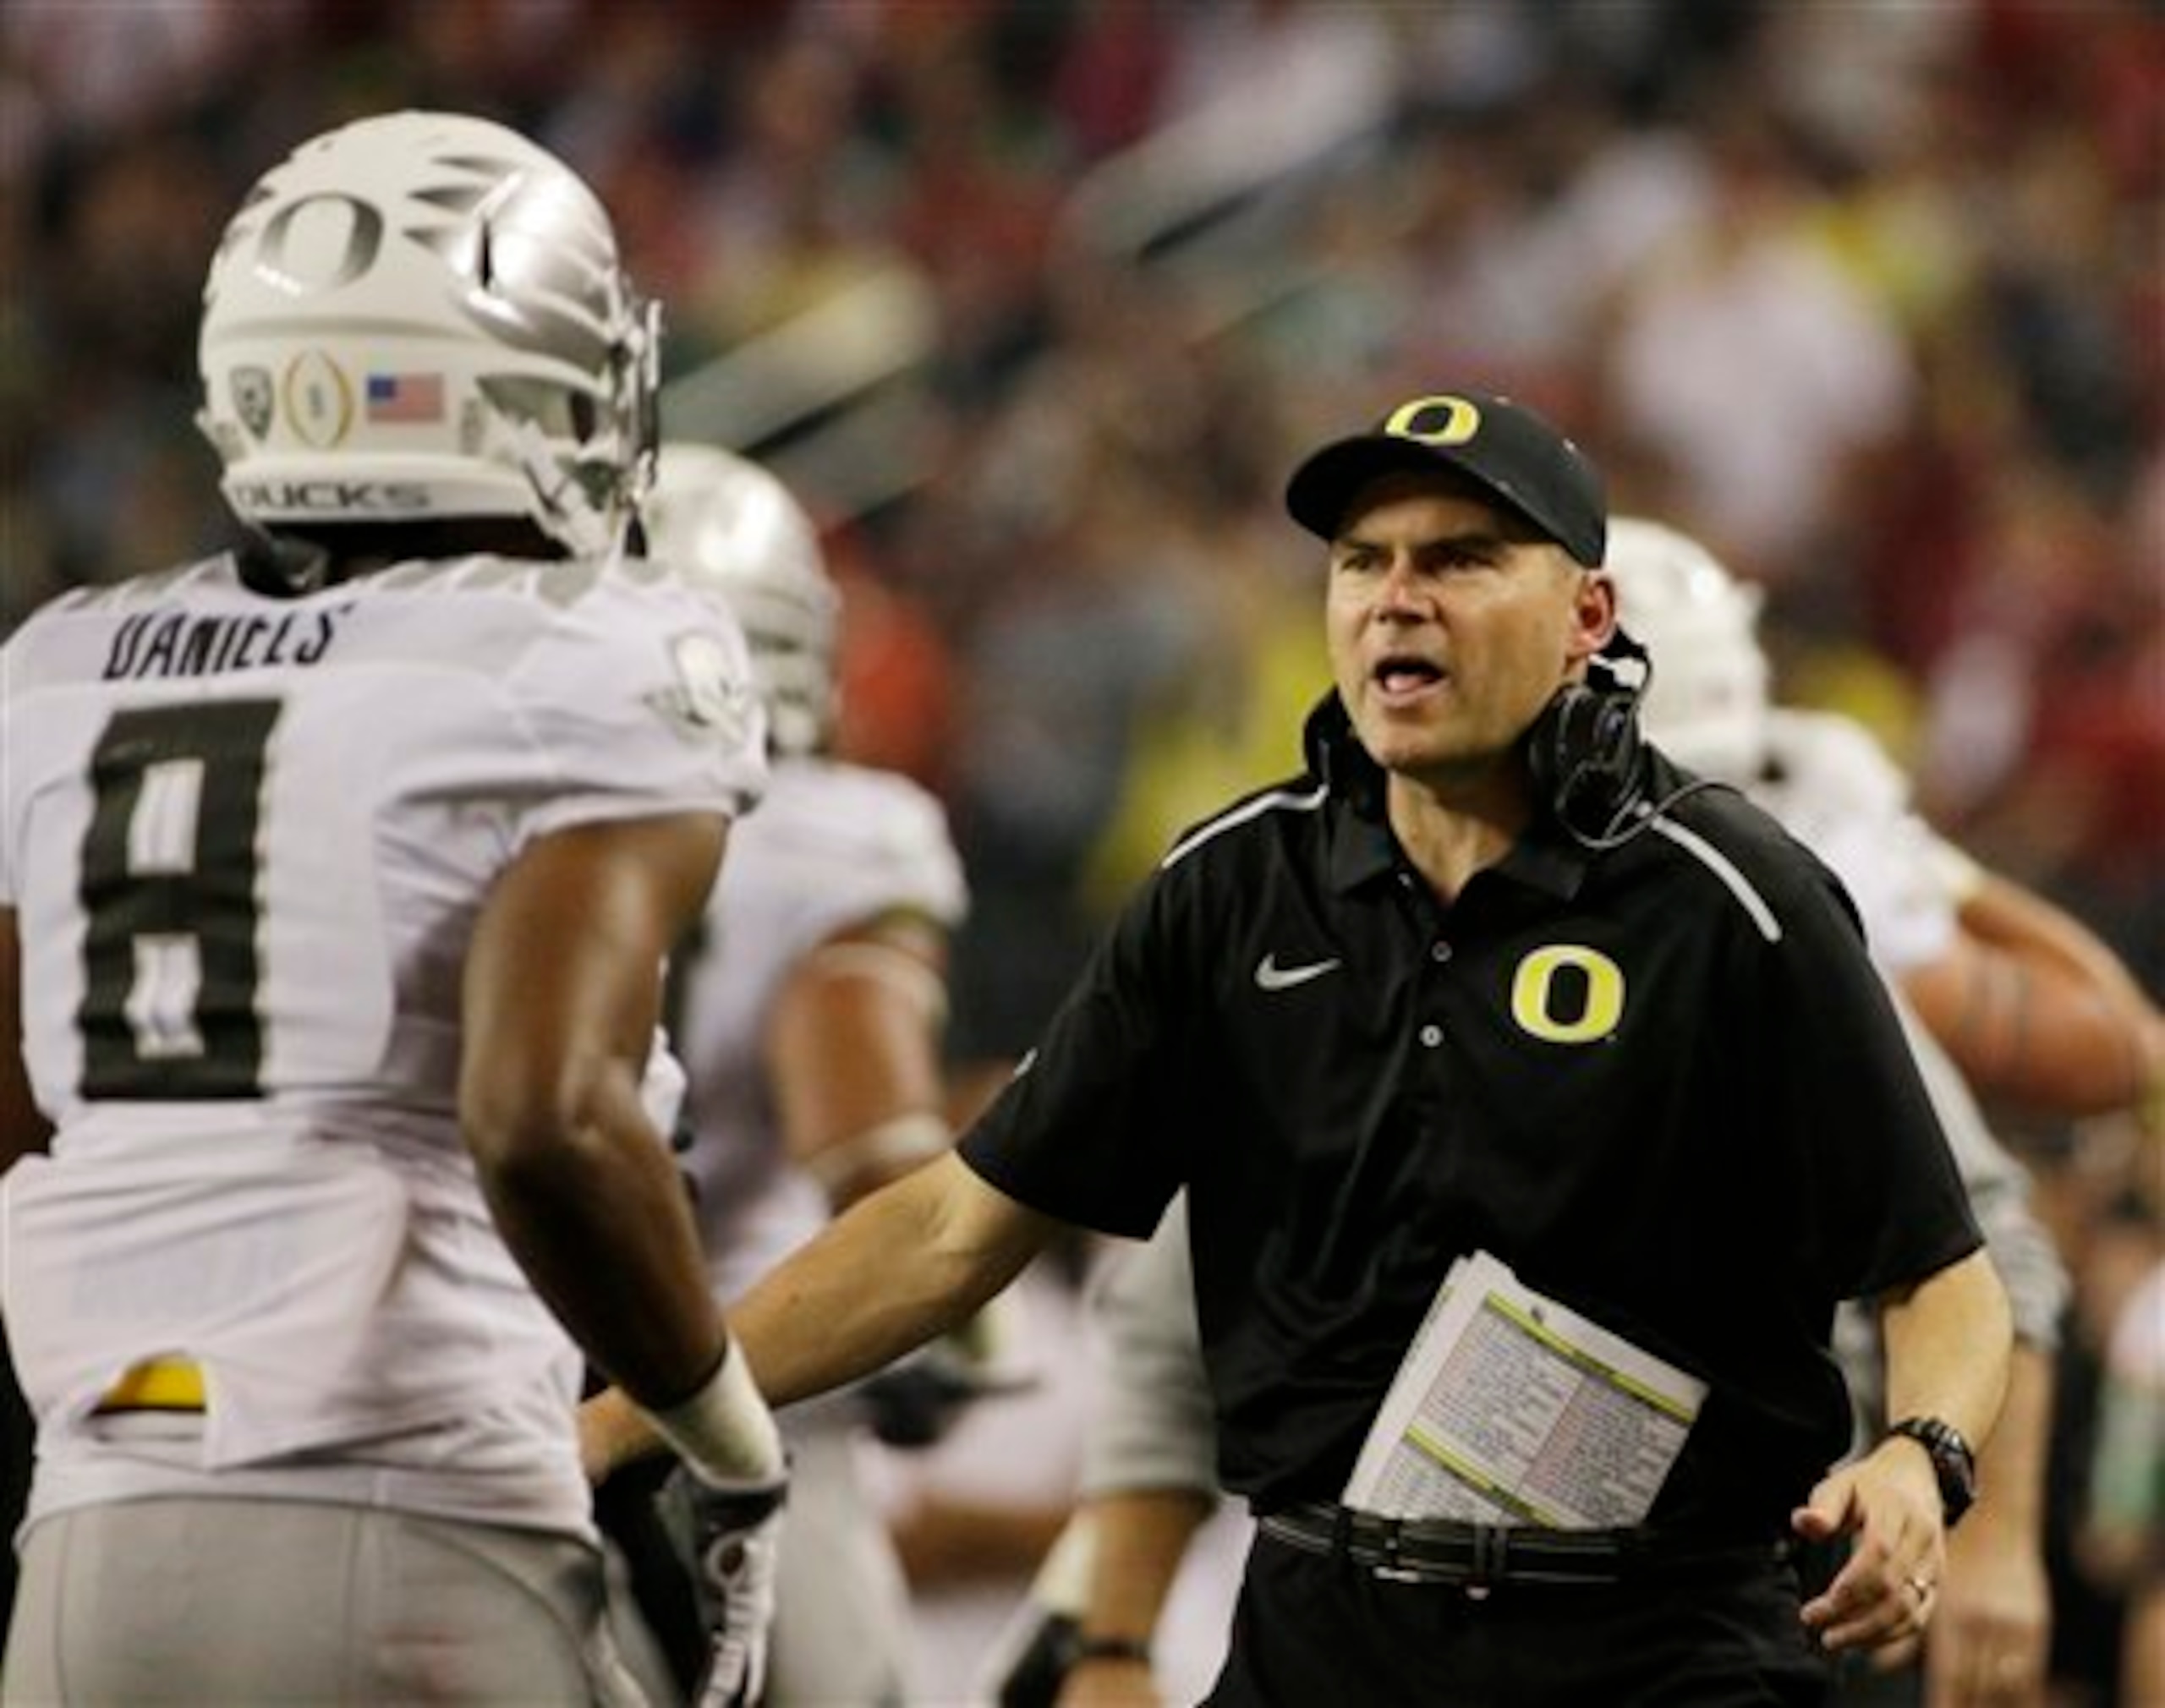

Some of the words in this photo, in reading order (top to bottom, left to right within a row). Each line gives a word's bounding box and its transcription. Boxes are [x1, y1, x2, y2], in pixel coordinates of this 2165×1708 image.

[257, 192, 384, 293] O
[1384, 396, 1481, 446] O
[102, 601, 355, 680] DANIELS
[78, 698, 282, 1100] 8
[1511, 944, 1625, 1043] O
